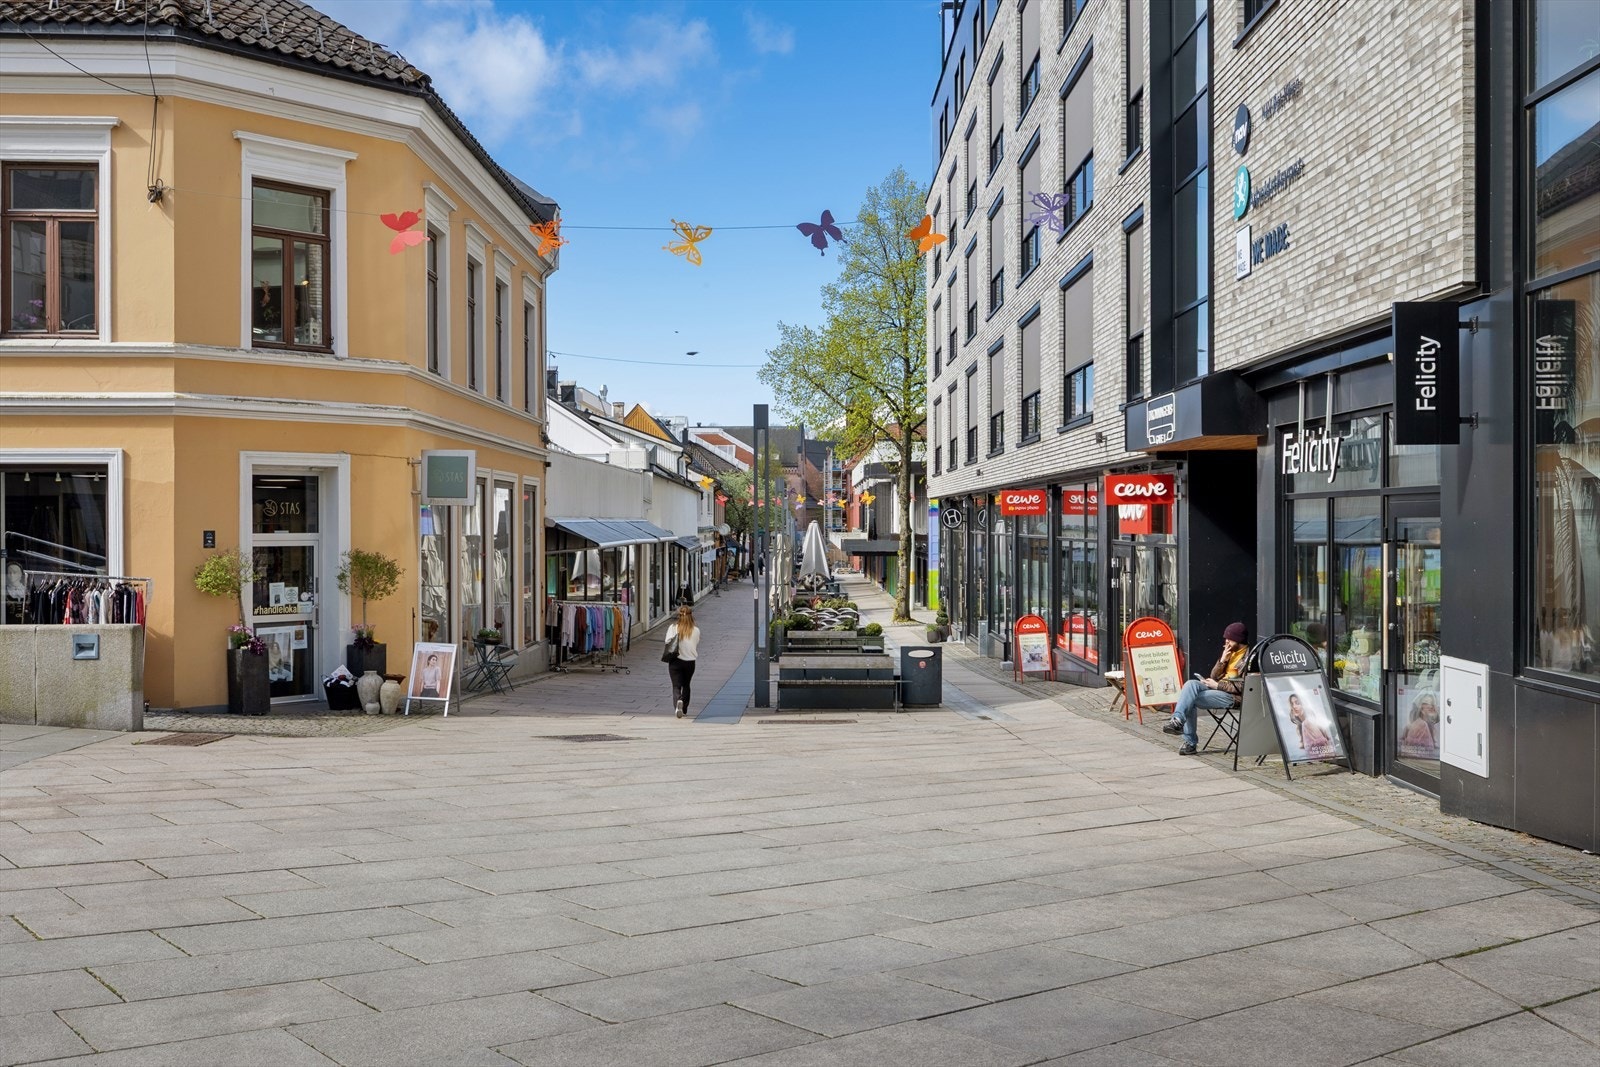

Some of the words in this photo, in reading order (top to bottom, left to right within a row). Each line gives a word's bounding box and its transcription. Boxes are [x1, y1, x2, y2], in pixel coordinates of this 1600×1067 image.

[1235, 121, 1247, 144] nav
[1252, 236, 1264, 266] WE
[1415, 335, 1441, 411] Felicity
[1282, 427, 1341, 484] Felicity
[1114, 482, 1168, 497] cewe
[1006, 494, 1041, 504] cewe
[280, 502, 301, 515] STAS
[1135, 630, 1164, 639] cewe
[1270, 650, 1308, 667] Felicity
